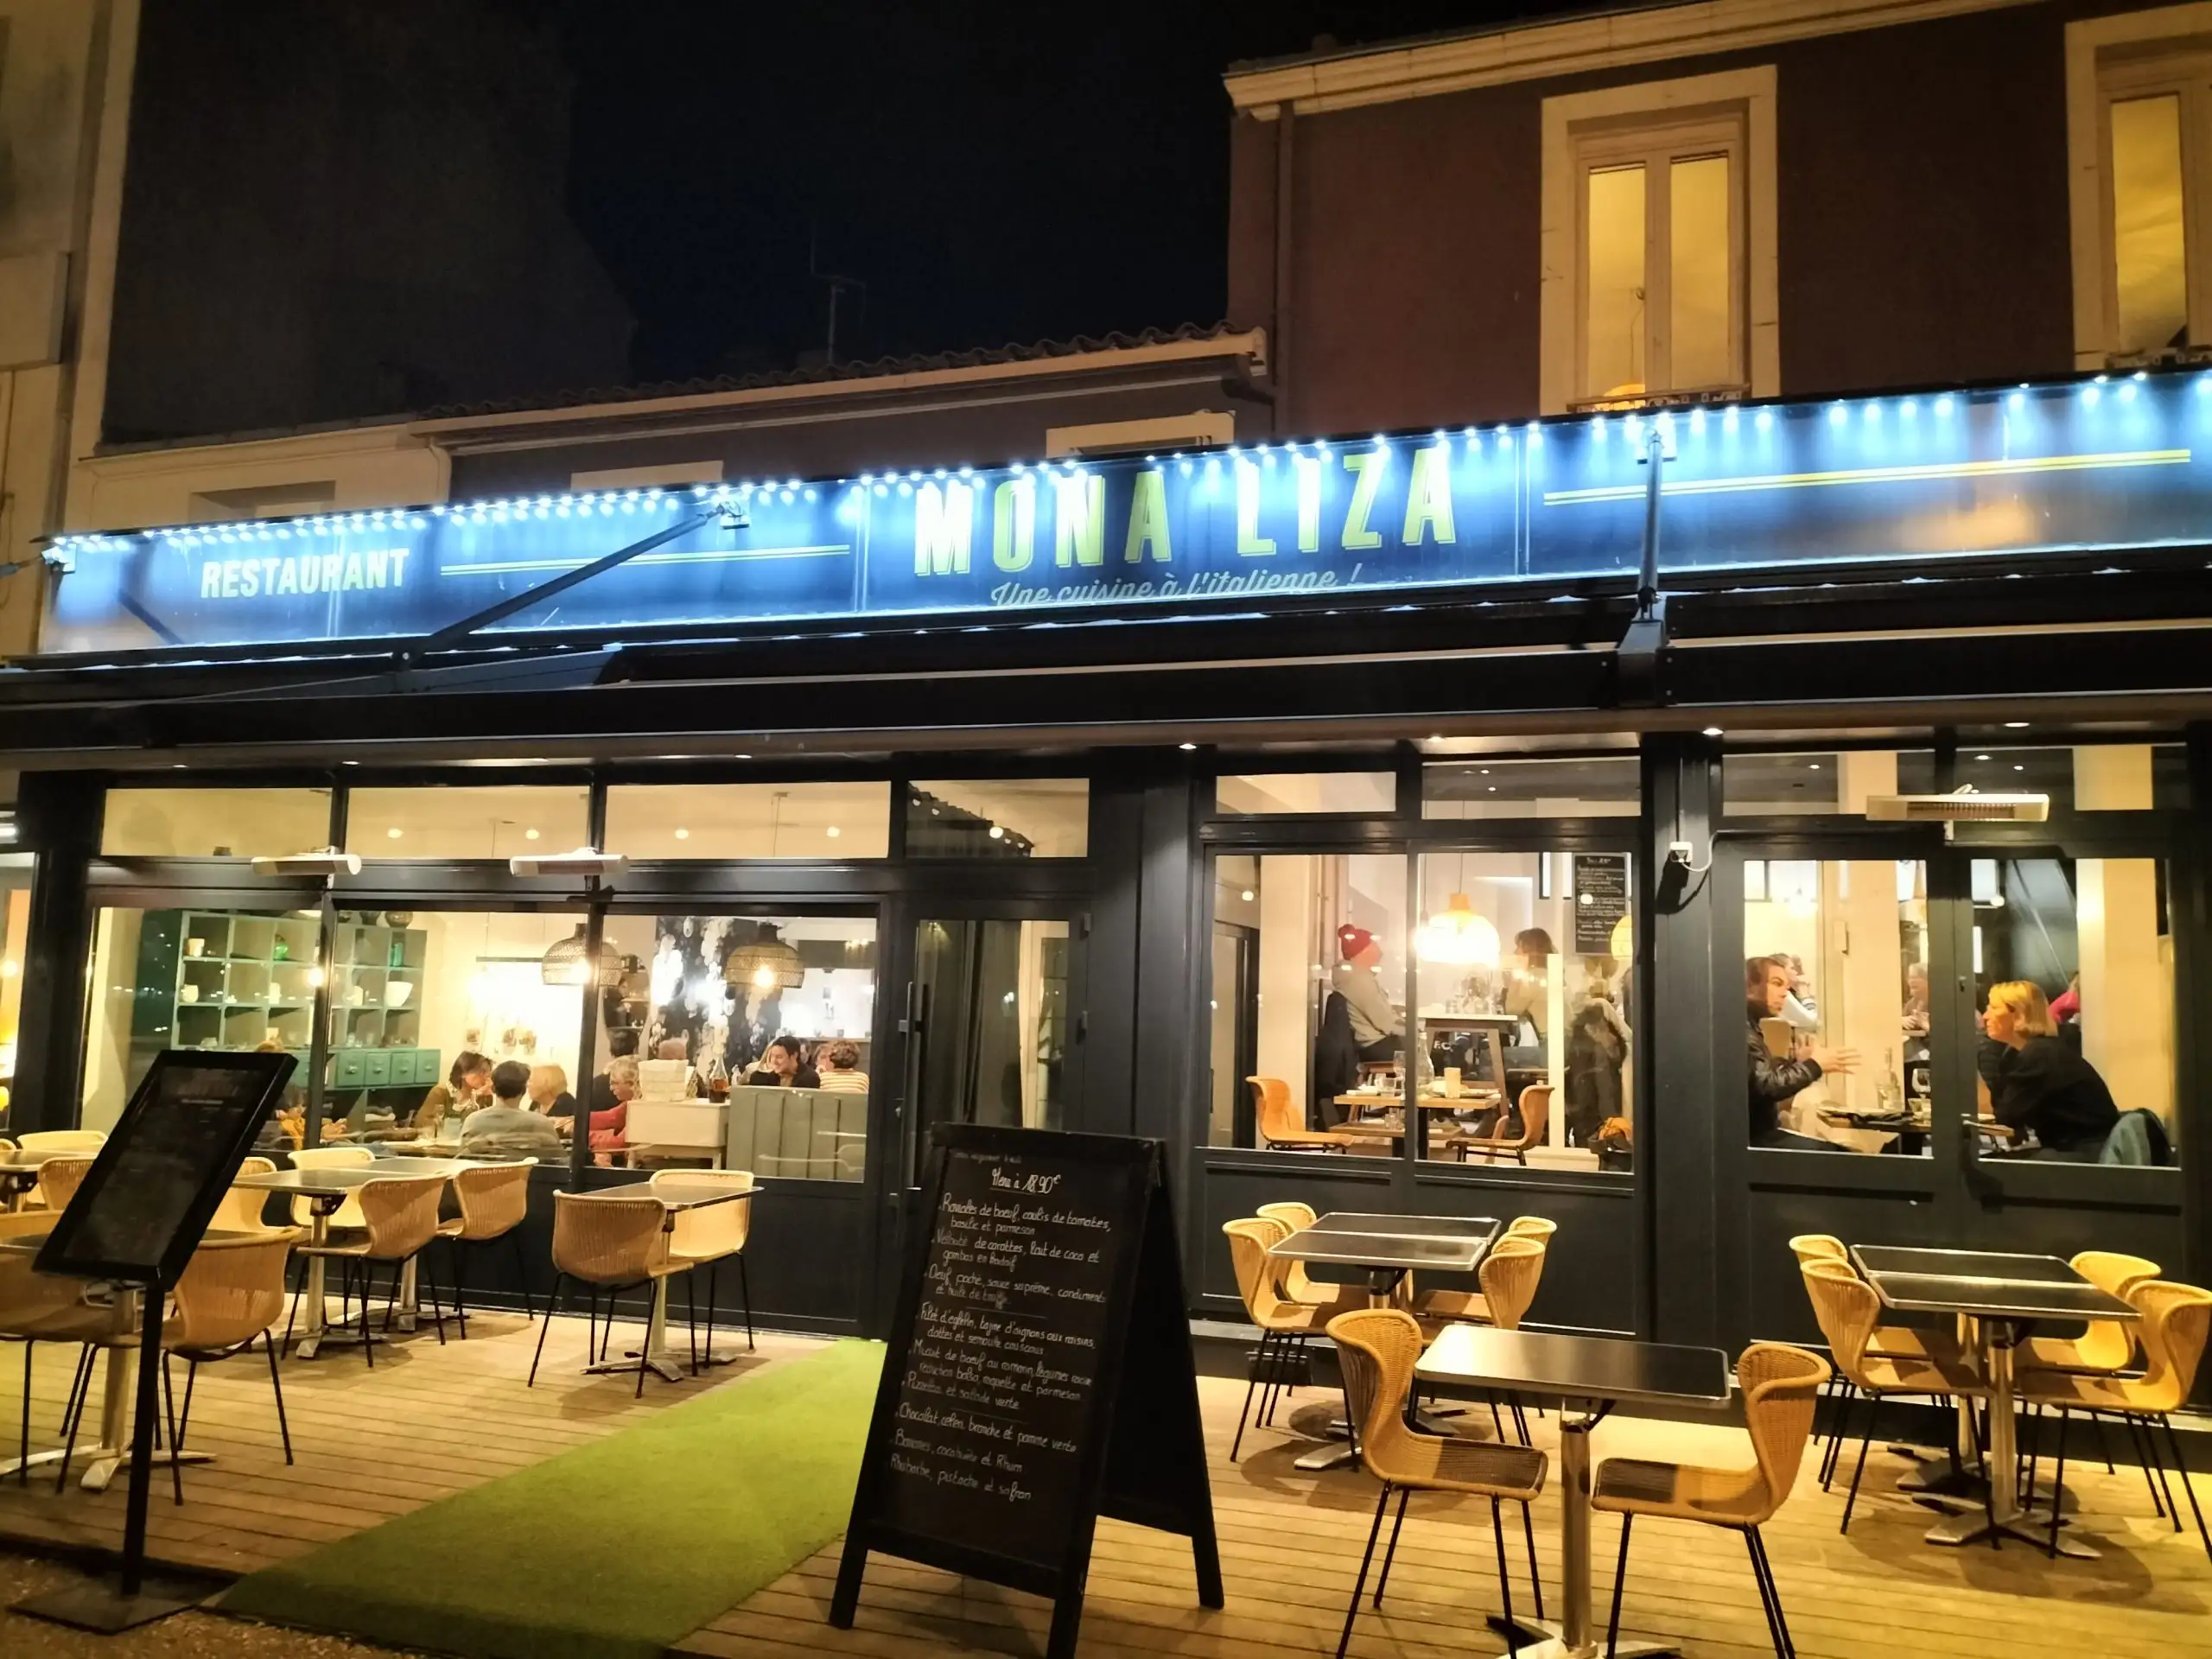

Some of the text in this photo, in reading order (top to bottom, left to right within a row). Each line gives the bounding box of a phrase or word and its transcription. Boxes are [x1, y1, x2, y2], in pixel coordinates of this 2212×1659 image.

[913, 448, 1456, 576] MONA LIZA
[200, 548, 410, 598] RESTAURANT
[991, 582, 1051, 606] Une
[1057, 577, 1155, 603] cuisine
[1160, 572, 1182, 597] à
[1187, 569, 1338, 595] l'italienne
[991, 1166, 1011, 1188] Menu
[979, 1203, 992, 1217] de
[1052, 1211, 1065, 1224] de
[981, 1219, 991, 1231] et
[974, 1236, 987, 1249] de
[1049, 1245, 1061, 1258] de
[1064, 1250, 1084, 1261] coco
[1088, 1250, 1099, 1262] et
